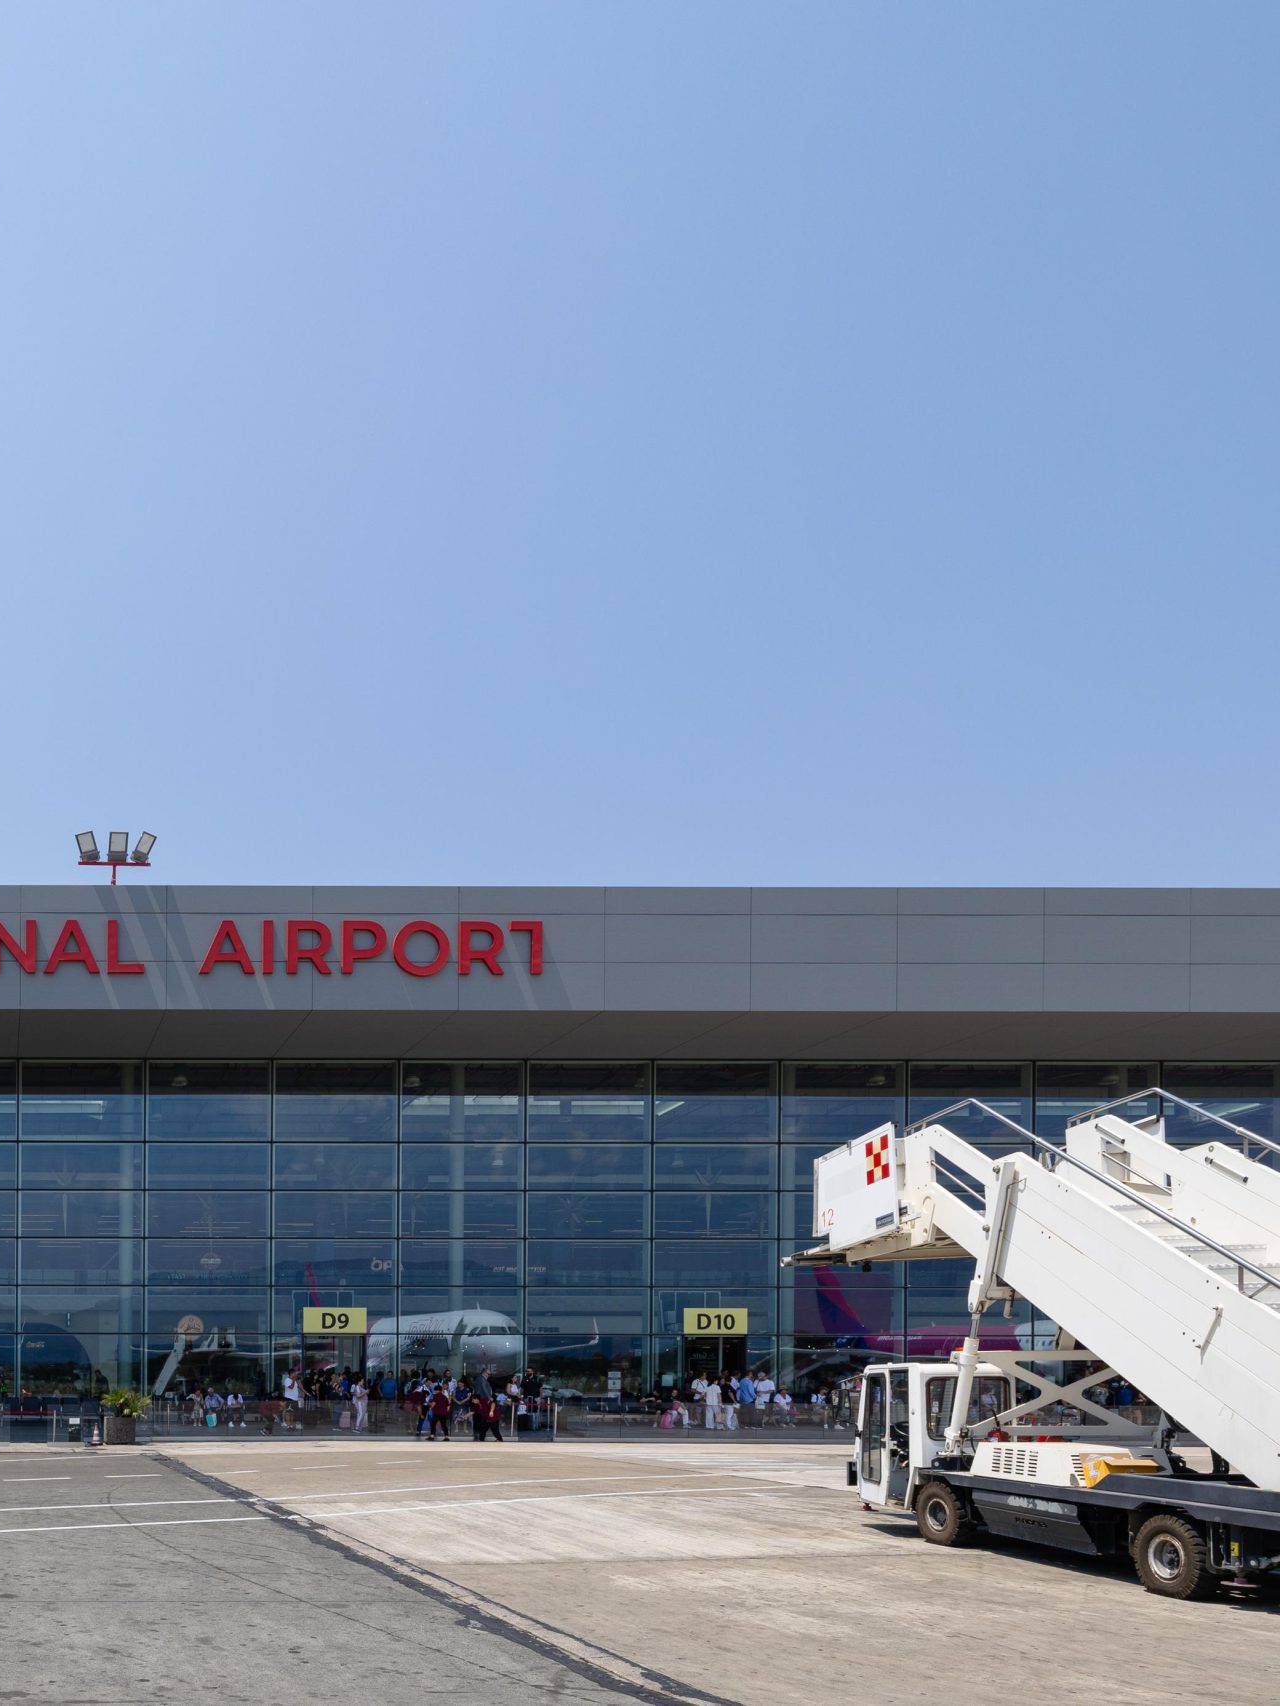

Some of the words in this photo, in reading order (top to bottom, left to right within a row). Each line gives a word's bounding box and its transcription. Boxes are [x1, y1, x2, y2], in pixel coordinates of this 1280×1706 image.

[199, 919, 544, 977] AIRPORT
[822, 1209, 834, 1227] 12
[321, 1312, 350, 1329] D9
[697, 1313, 736, 1330] D10
